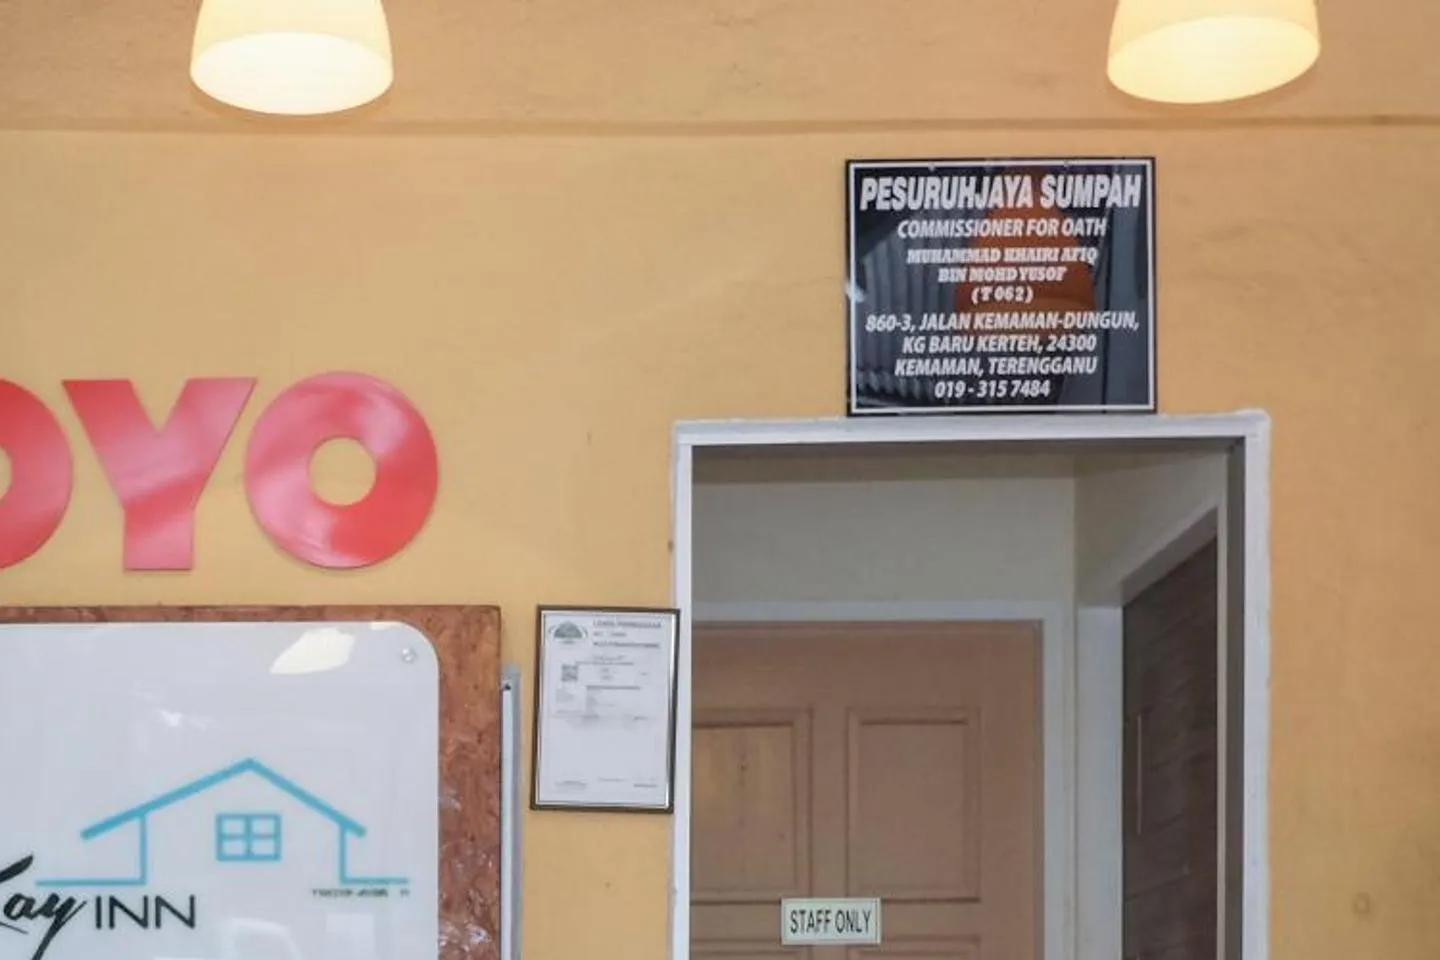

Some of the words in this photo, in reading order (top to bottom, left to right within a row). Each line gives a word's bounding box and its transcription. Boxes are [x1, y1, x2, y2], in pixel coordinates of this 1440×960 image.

[860, 176, 1034, 210] PESURUHJAYA
[1040, 174, 1142, 208] SUMPAH
[897, 219, 1024, 239] COMMISSIONER
[1027, 218, 1059, 237] FOR
[1062, 218, 1107, 236] OATH
[907, 248, 1002, 264] MUHAMMAD
[938, 268, 968, 283] BIN
[969, 267, 1018, 282] MOHD
[866, 314, 916, 333] 860-3,
[919, 313, 971, 331] JALAN
[973, 311, 1140, 331] KEMAMAN-DUNGUN,
[903, 336, 926, 354] KG
[929, 335, 974, 353] BARU
[976, 334, 1043, 355] KERTEH,
[1046, 334, 1097, 352] 24300
[895, 358, 984, 377] KEMAMAN,
[988, 356, 1098, 375] TERENGGANU
[935, 380, 966, 398] 019
[977, 380, 1007, 398] 315
[1011, 379, 1051, 397] 7484
[95, 894, 197, 930] INN
[790, 908, 832, 934] STAFF
[835, 908, 871, 934] ONLY
